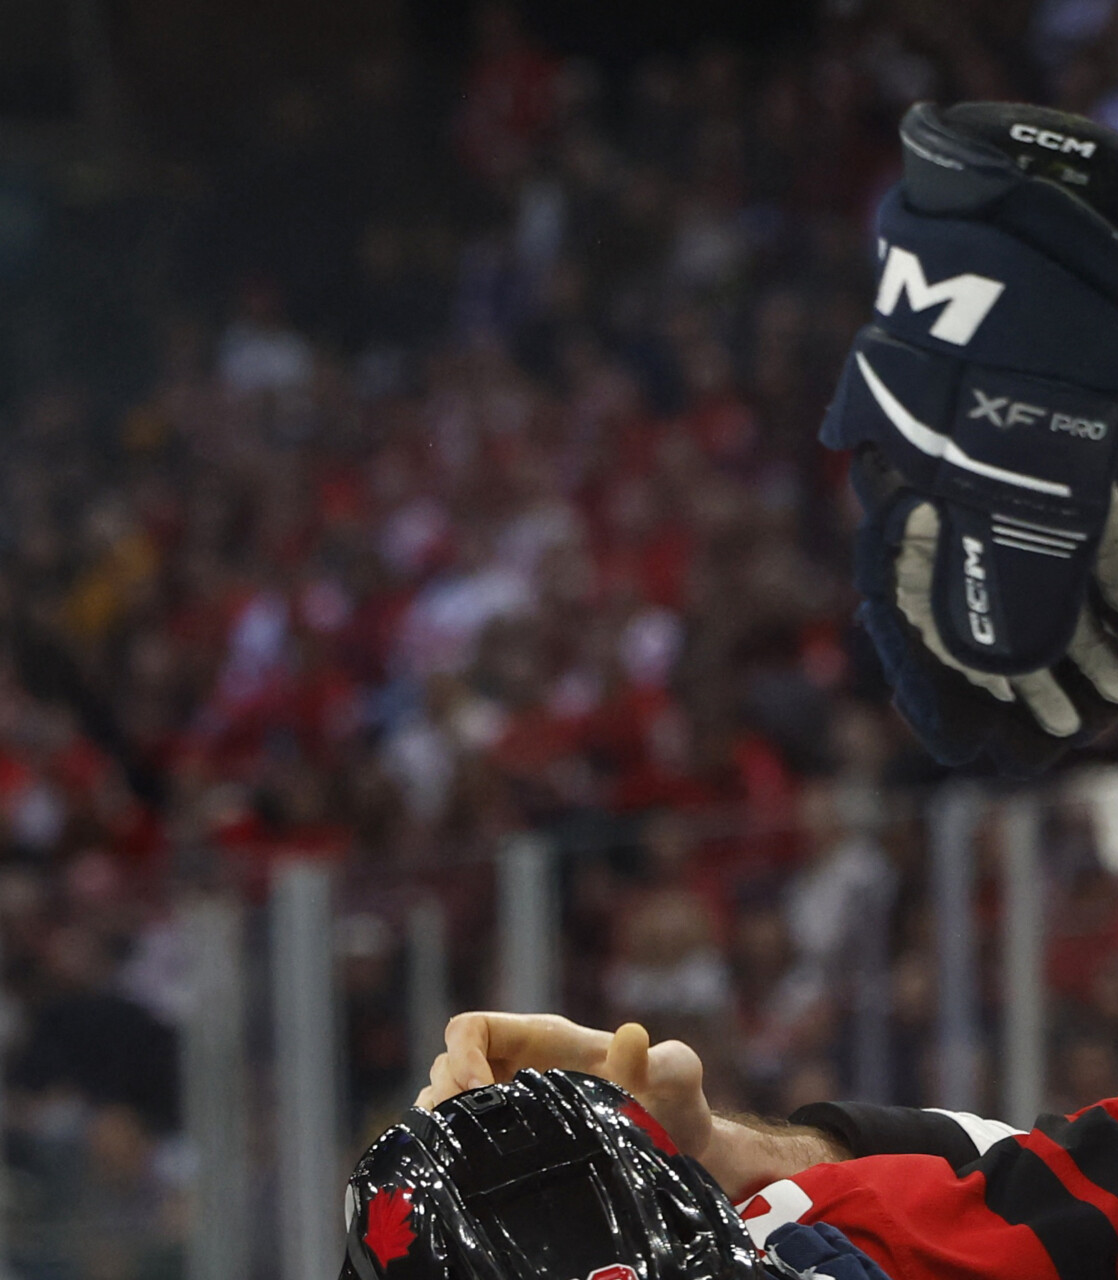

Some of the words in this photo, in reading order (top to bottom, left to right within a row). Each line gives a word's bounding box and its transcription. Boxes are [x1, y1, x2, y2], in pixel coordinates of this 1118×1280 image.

[1010, 124, 1097, 158] CCM
[969, 388, 1046, 428] XF
[1050, 413, 1107, 440] PRO
[962, 536, 996, 645] CCM
